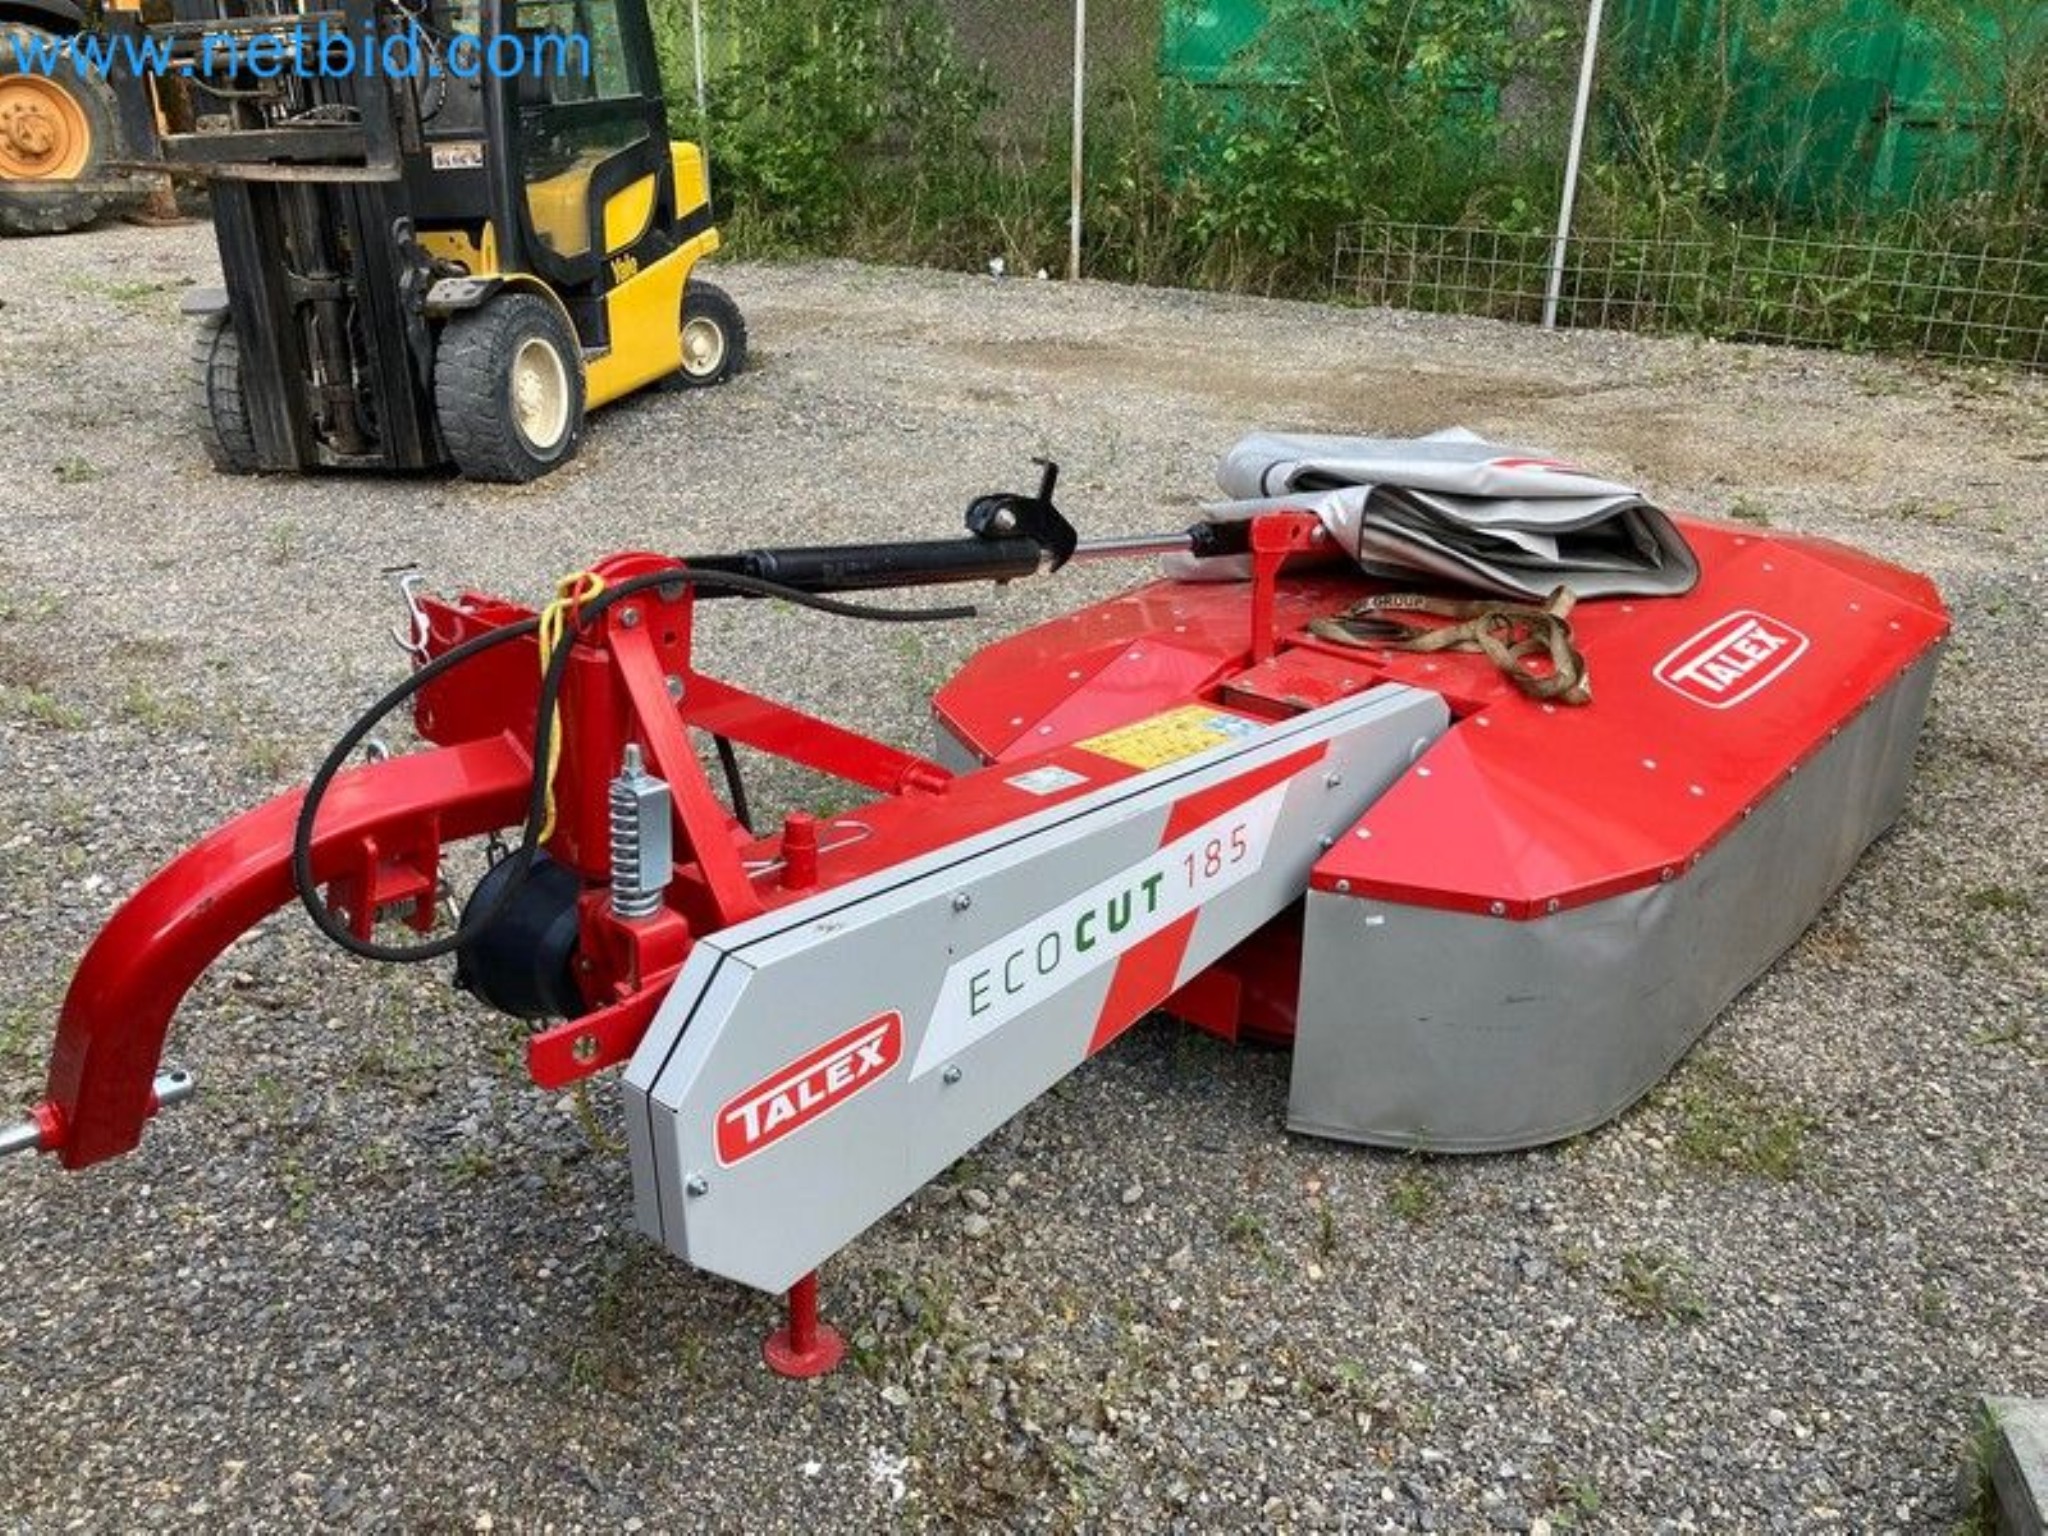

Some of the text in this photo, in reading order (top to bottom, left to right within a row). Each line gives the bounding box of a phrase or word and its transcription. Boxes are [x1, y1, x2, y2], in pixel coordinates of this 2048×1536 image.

[1669, 618, 1788, 692] TALEX
[969, 823, 1247, 1017] ECOCUT 185
[724, 1022, 891, 1144] TALEX
